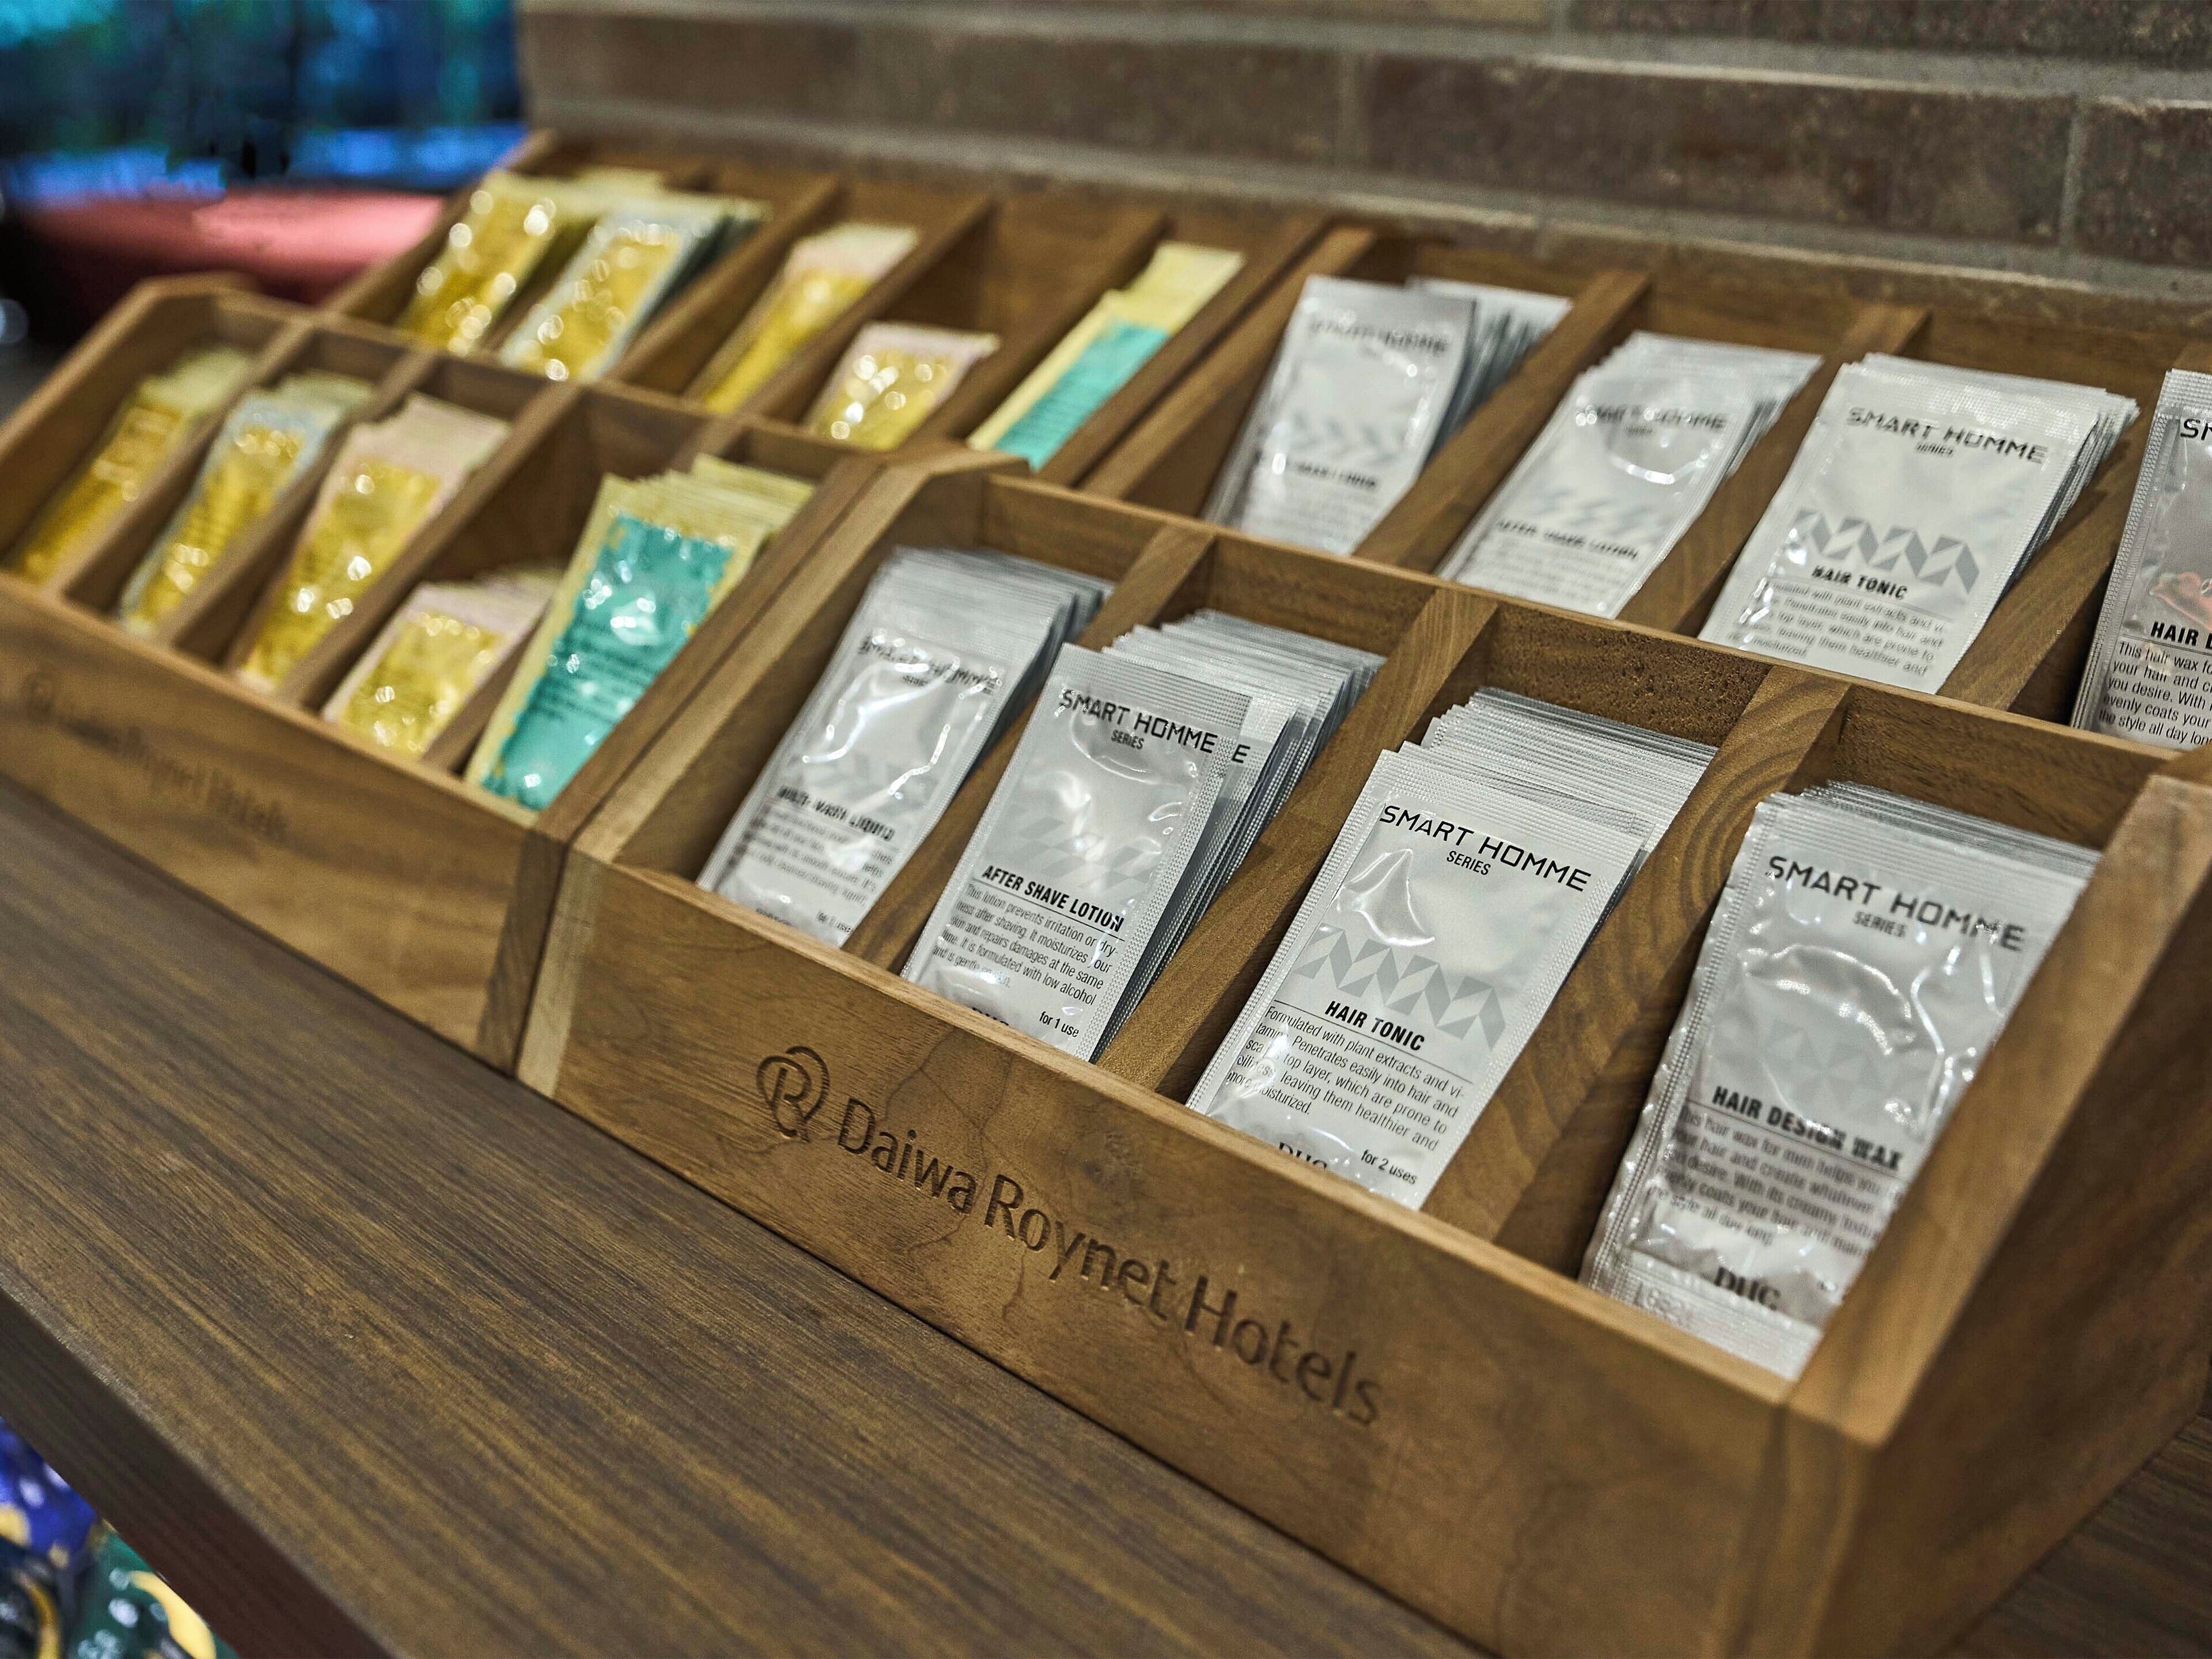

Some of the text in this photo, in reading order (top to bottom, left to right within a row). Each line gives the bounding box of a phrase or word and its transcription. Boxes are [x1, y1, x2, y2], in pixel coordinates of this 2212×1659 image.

[1846, 406, 2049, 464] SMART HOMME
[1810, 565, 1908, 600] HAIR TONIC
[1910, 615, 1932, 629] and
[2150, 620, 2199, 646] HAIR
[1920, 634, 1944, 650] and
[2119, 641, 2142, 659] This
[2173, 656, 2199, 672] wax
[2202, 660, 2212, 676] fo
[2108, 676, 2206, 710] you desire. With
[2113, 660, 2139, 676] your
[2173, 675, 2199, 690] and
[1060, 689, 1130, 725] SMART
[1134, 712, 1218, 754] HOMME
[2103, 694, 2212, 729] evenly coats your
[2118, 715, 2146, 732] style
[2149, 722, 2164, 736] all
[2165, 726, 2188, 744] day
[1111, 729, 1145, 750] SERIES
[1379, 805, 1592, 892] SMART HOMME
[1446, 850, 1491, 876] SERIES
[982, 865, 1124, 933] AFTER SHAVE LOTION
[1765, 855, 2026, 952] SMART HOMME
[975, 908, 995, 923] after
[1029, 929, 1037, 942] It
[1037, 933, 1089, 963] moisturizes
[1005, 903, 1044, 925] prevents
[1044, 915, 1084, 942] irritation
[1085, 935, 1097, 947] or
[1853, 910, 1907, 938] SERIES
[978, 943, 1023, 973] formulated
[1022, 966, 1043, 982] with
[1042, 972, 1060, 990] low
[1060, 983, 1097, 1006] alcohol
[979, 929, 1009, 949] repairs
[1009, 940, 1049, 966] damages
[1048, 959, 1061, 971] at
[1060, 961, 1076, 978] the
[1075, 970, 1104, 990] same
[1039, 1011, 1080, 1038] for 1 use
[1324, 1000, 1425, 1052] HAIR TONIC
[1264, 1006, 1323, 1037] Formulated
[1322, 1029, 1345, 1047] with
[1344, 1040, 1375, 1059] plant
[1375, 1051, 1423, 1080] extracts
[1422, 1074, 1449, 1092] and
[1283, 1053, 1447, 1135] top layer, which are prone to
[1291, 1035, 1349, 1069] Penetrates
[1349, 1062, 1382, 1084] easily
[1382, 1073, 1406, 1094] into
[1407, 1085, 1432, 1104] hair
[1433, 1099, 1459, 1119] and
[1254, 1083, 1312, 1115] oisturized.
[1279, 1070, 1321, 1100] leaving
[1323, 1089, 1354, 1112] them
[1355, 1103, 1411, 1137] healthier
[1412, 1132, 1440, 1152] and
[1712, 1085, 1763, 1123] HAIR
[1361, 1149, 1418, 1185] for 2 uses
[837, 1098, 1383, 1427] Daiwa Roynet Hotels
